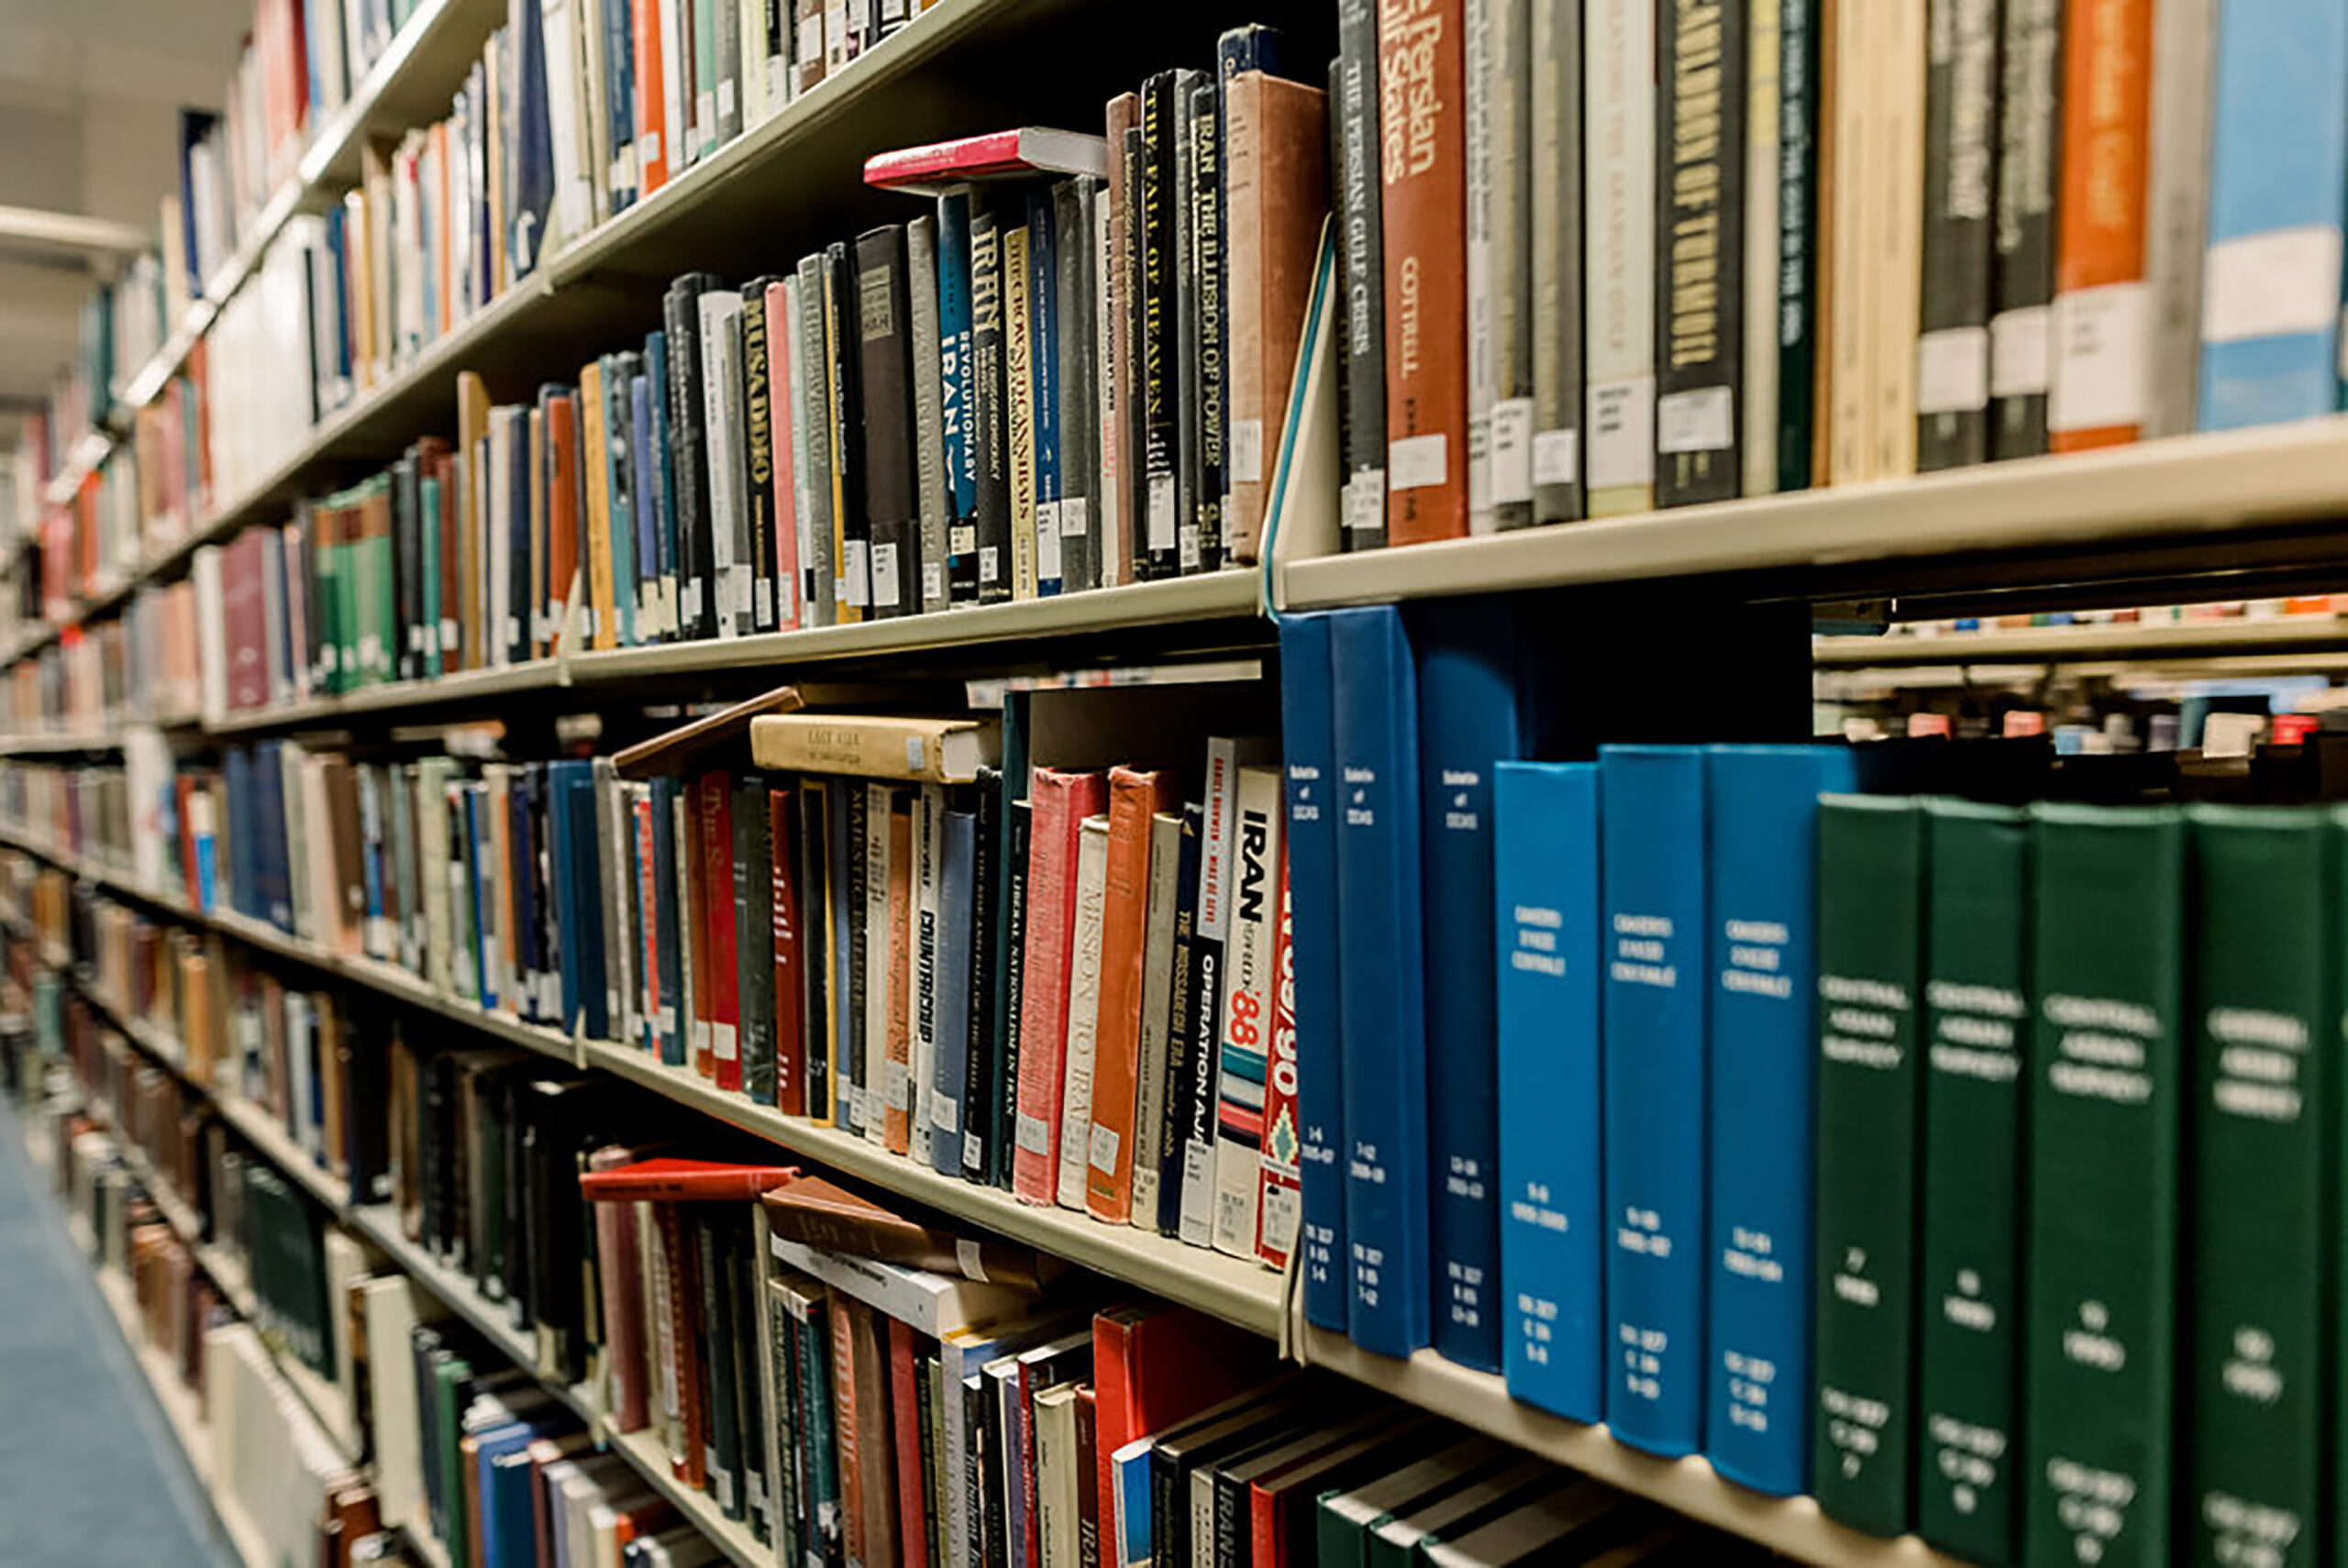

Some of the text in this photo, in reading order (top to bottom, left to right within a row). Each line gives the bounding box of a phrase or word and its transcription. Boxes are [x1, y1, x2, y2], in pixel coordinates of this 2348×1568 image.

[1383, 48, 1409, 185] States
[1409, 15, 1443, 177] Persian
[1145, 90, 1162, 414] THE FALL OF HEAVEN
[1346, 59, 1371, 356] THE PERSIAN GULF CRISIS
[971, 226, 1001, 337] IRAN
[1198, 111, 1222, 466] IRAN THE ILLUSION OF POWER
[1401, 256, 1419, 381] COTTRELL
[941, 335, 959, 436] IRAN
[959, 330, 976, 480] REVOLUTIONARY
[1010, 874, 1024, 940] LIBERAL
[1239, 809, 1268, 922] IRAN
[919, 908, 936, 1043] COUNTERCOUP
[1008, 944, 1021, 1048] NATIONALISM
[1079, 886, 1102, 999] MISSION
[1171, 944, 1190, 1034] MOSSADEGH
[1007, 1054, 1015, 1073] IN
[1074, 1020, 1093, 1055] TO
[1169, 1037, 1183, 1067] ERA
[1195, 954, 1214, 1097] OPERATION
[1230, 989, 1261, 1046] '88
[965, 1452, 980, 1541] Turbulent
[1080, 1518, 1098, 1568] IRA
[1218, 1483, 1235, 1557] IRAN
